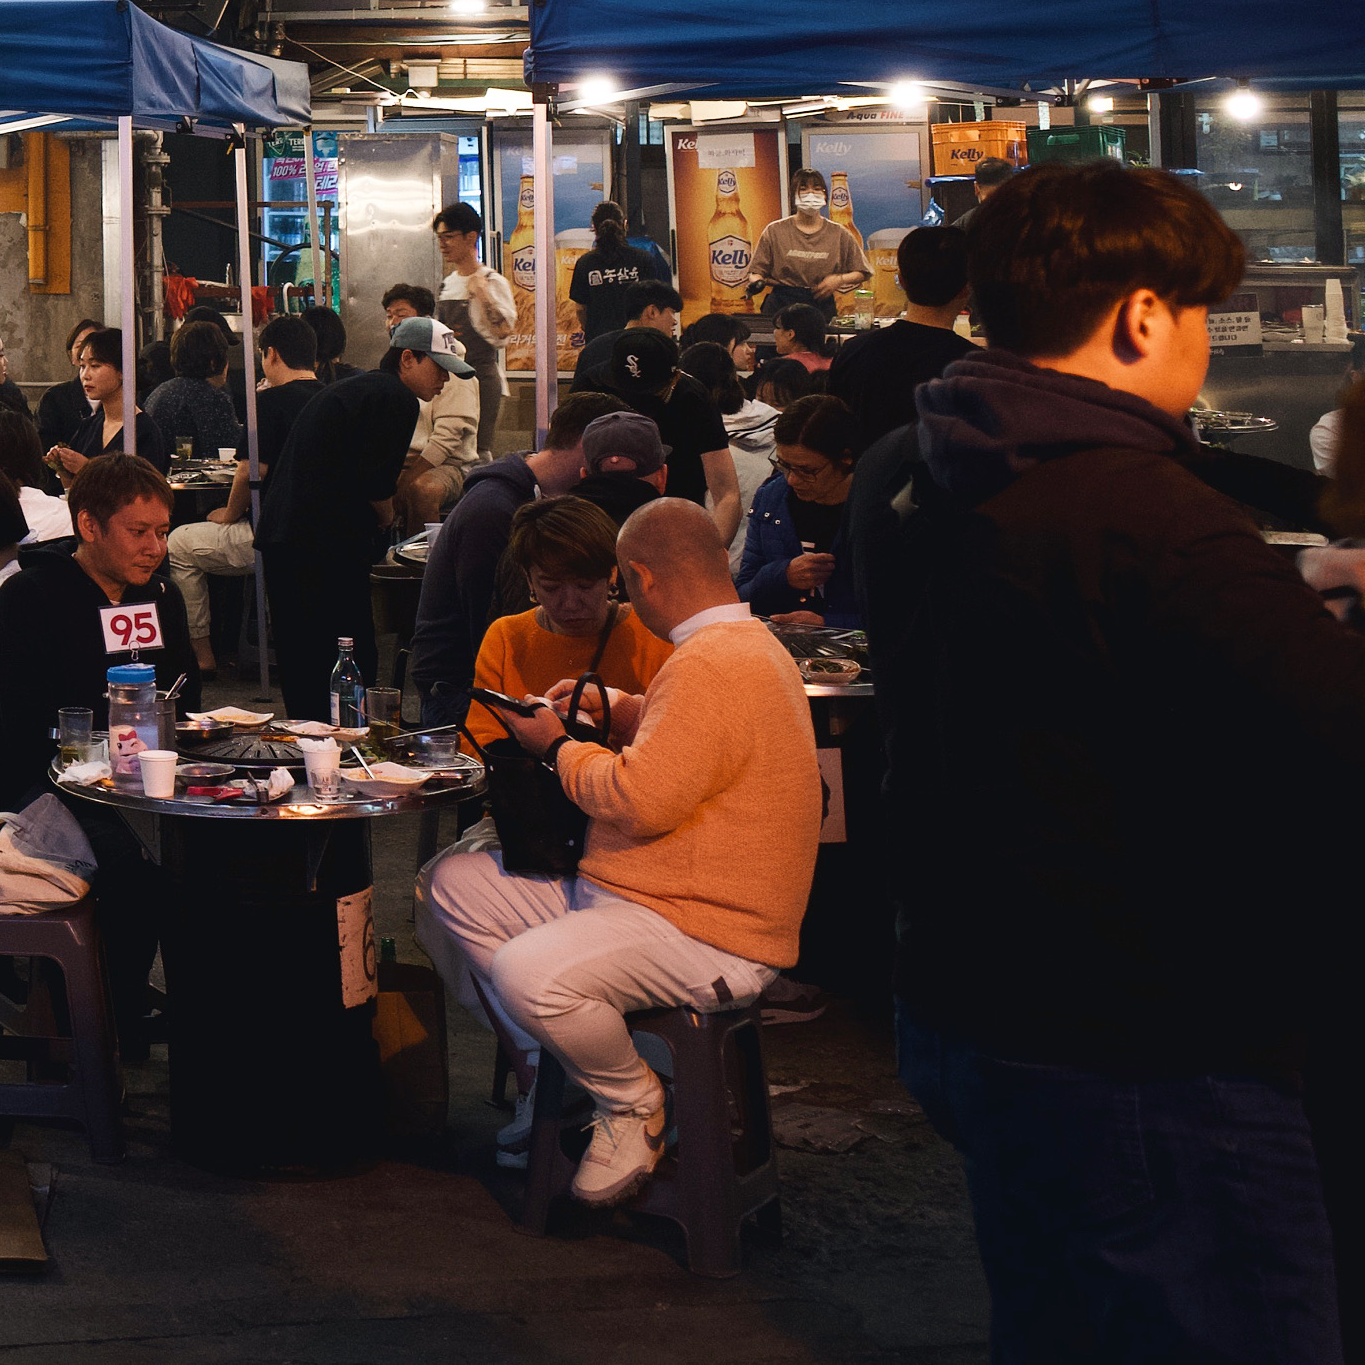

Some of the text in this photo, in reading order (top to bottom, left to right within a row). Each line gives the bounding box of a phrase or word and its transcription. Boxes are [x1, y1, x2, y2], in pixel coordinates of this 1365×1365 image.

[677, 138, 699, 150] Kel
[816, 142, 852, 156] Kelly
[951, 148, 984, 162] Kelly
[514, 256, 536, 272] Kel
[711, 249, 752, 270] Kelly
[109, 611, 158, 647] 95
